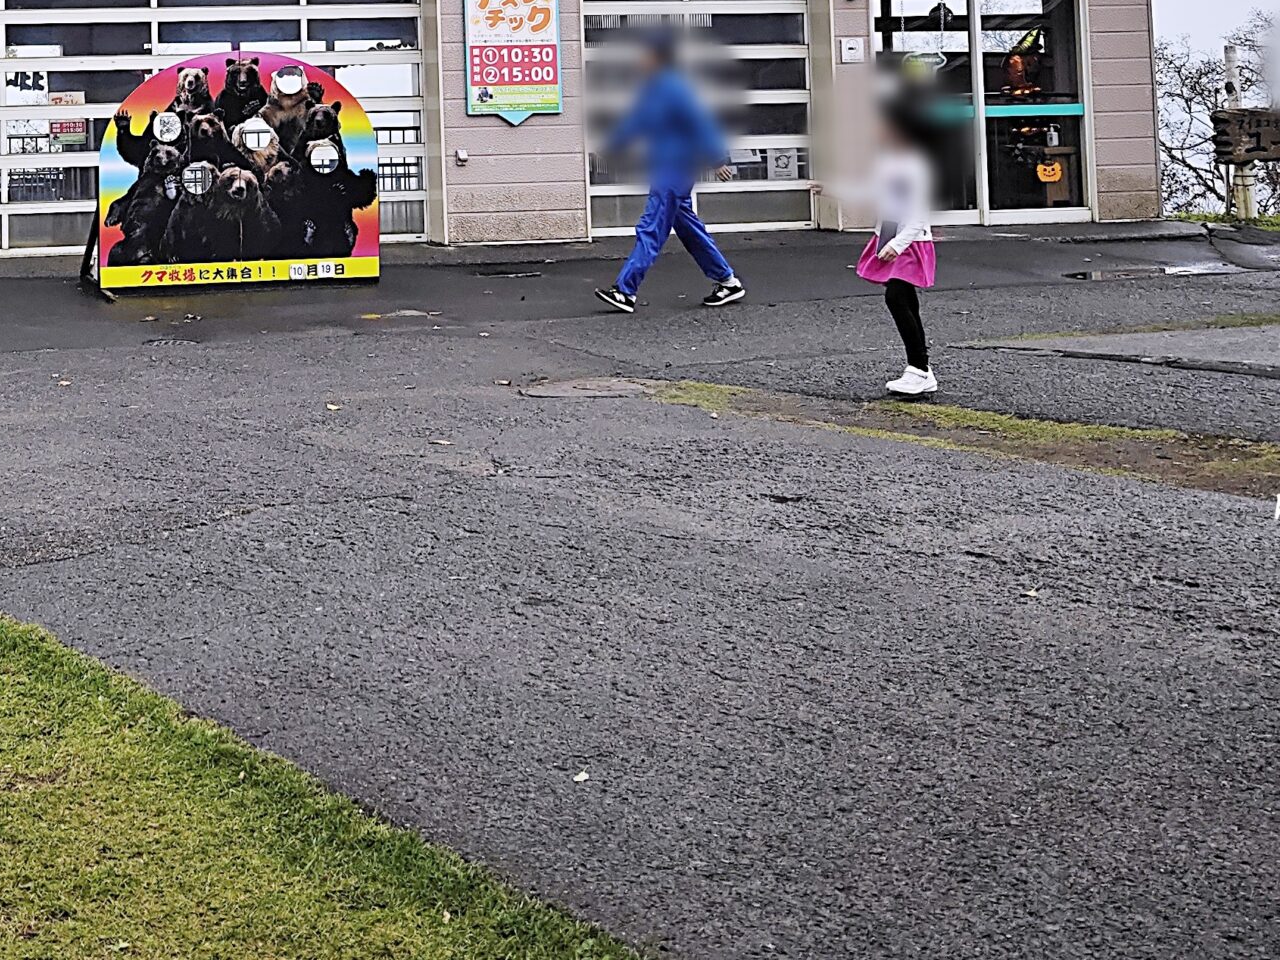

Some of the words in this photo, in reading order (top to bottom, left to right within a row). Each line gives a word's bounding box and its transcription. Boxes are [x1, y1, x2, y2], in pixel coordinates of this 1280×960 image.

[484, 5, 552, 33] チック
[140, 265, 277, 283] クマ牧場に大集合！！
[292, 262, 345, 277] 10月19日
